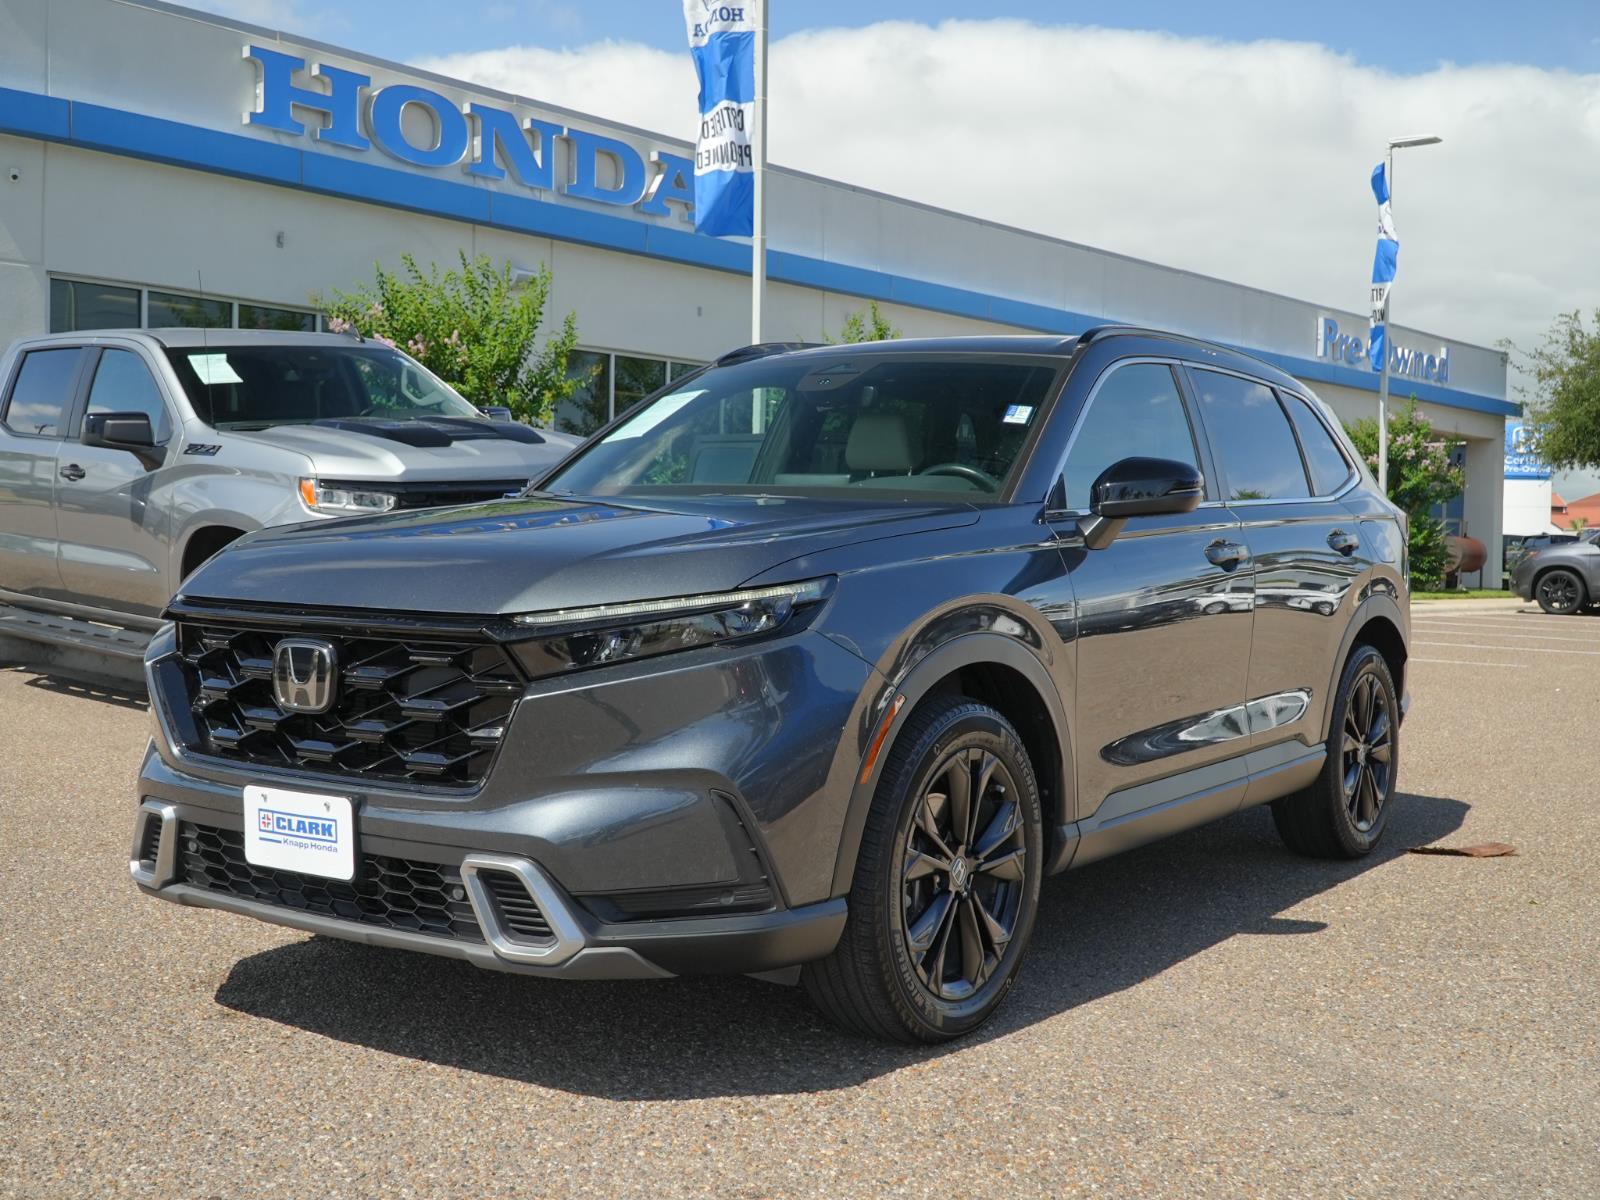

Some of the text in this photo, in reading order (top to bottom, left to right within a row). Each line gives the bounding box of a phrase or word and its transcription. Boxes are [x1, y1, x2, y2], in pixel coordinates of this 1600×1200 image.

[242, 45, 696, 224] HONDA
[275, 816, 334, 838] CLARK
[282, 838, 338, 853] Knapp Honda
